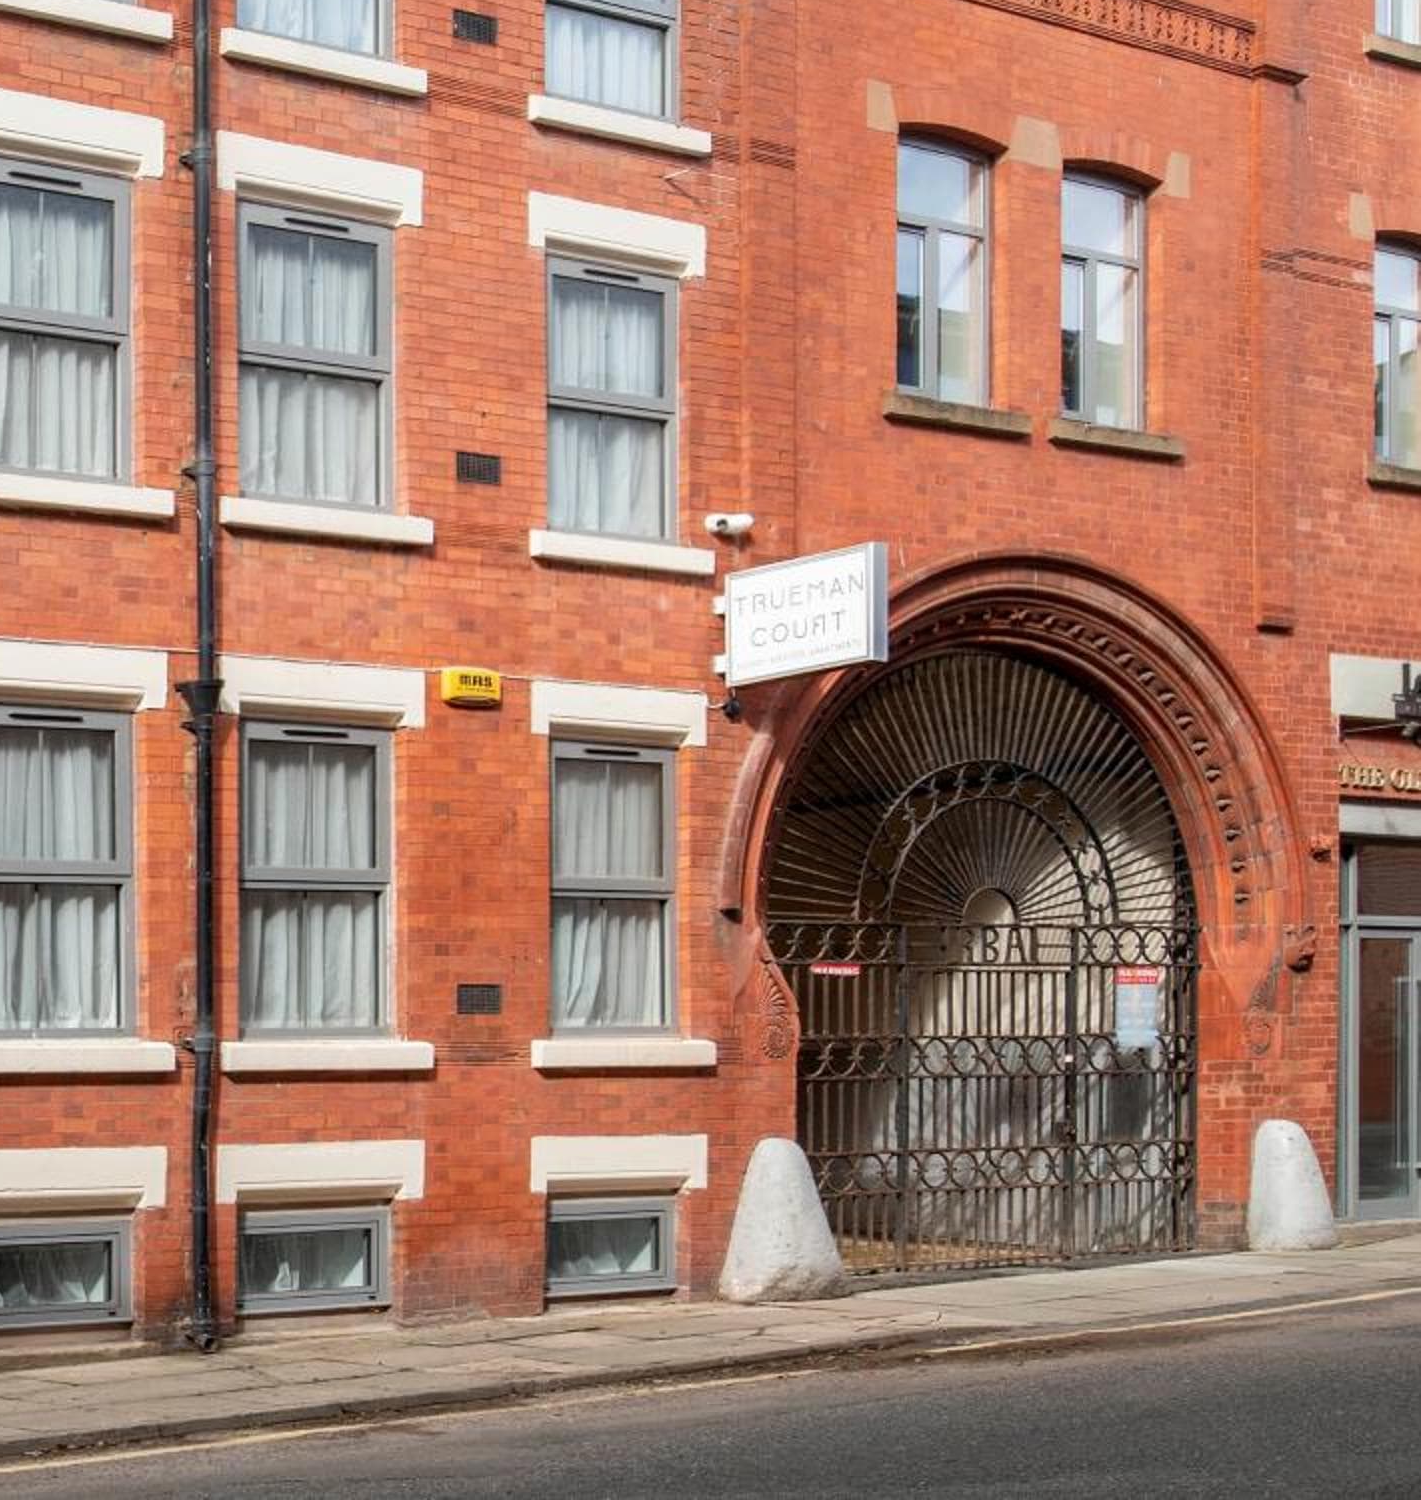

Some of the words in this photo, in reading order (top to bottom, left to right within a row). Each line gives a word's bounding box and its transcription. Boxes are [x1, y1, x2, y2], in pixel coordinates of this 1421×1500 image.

[734, 571, 864, 617] TRUEMAN
[751, 608, 847, 647] COURT
[1339, 763, 1385, 787] THE
